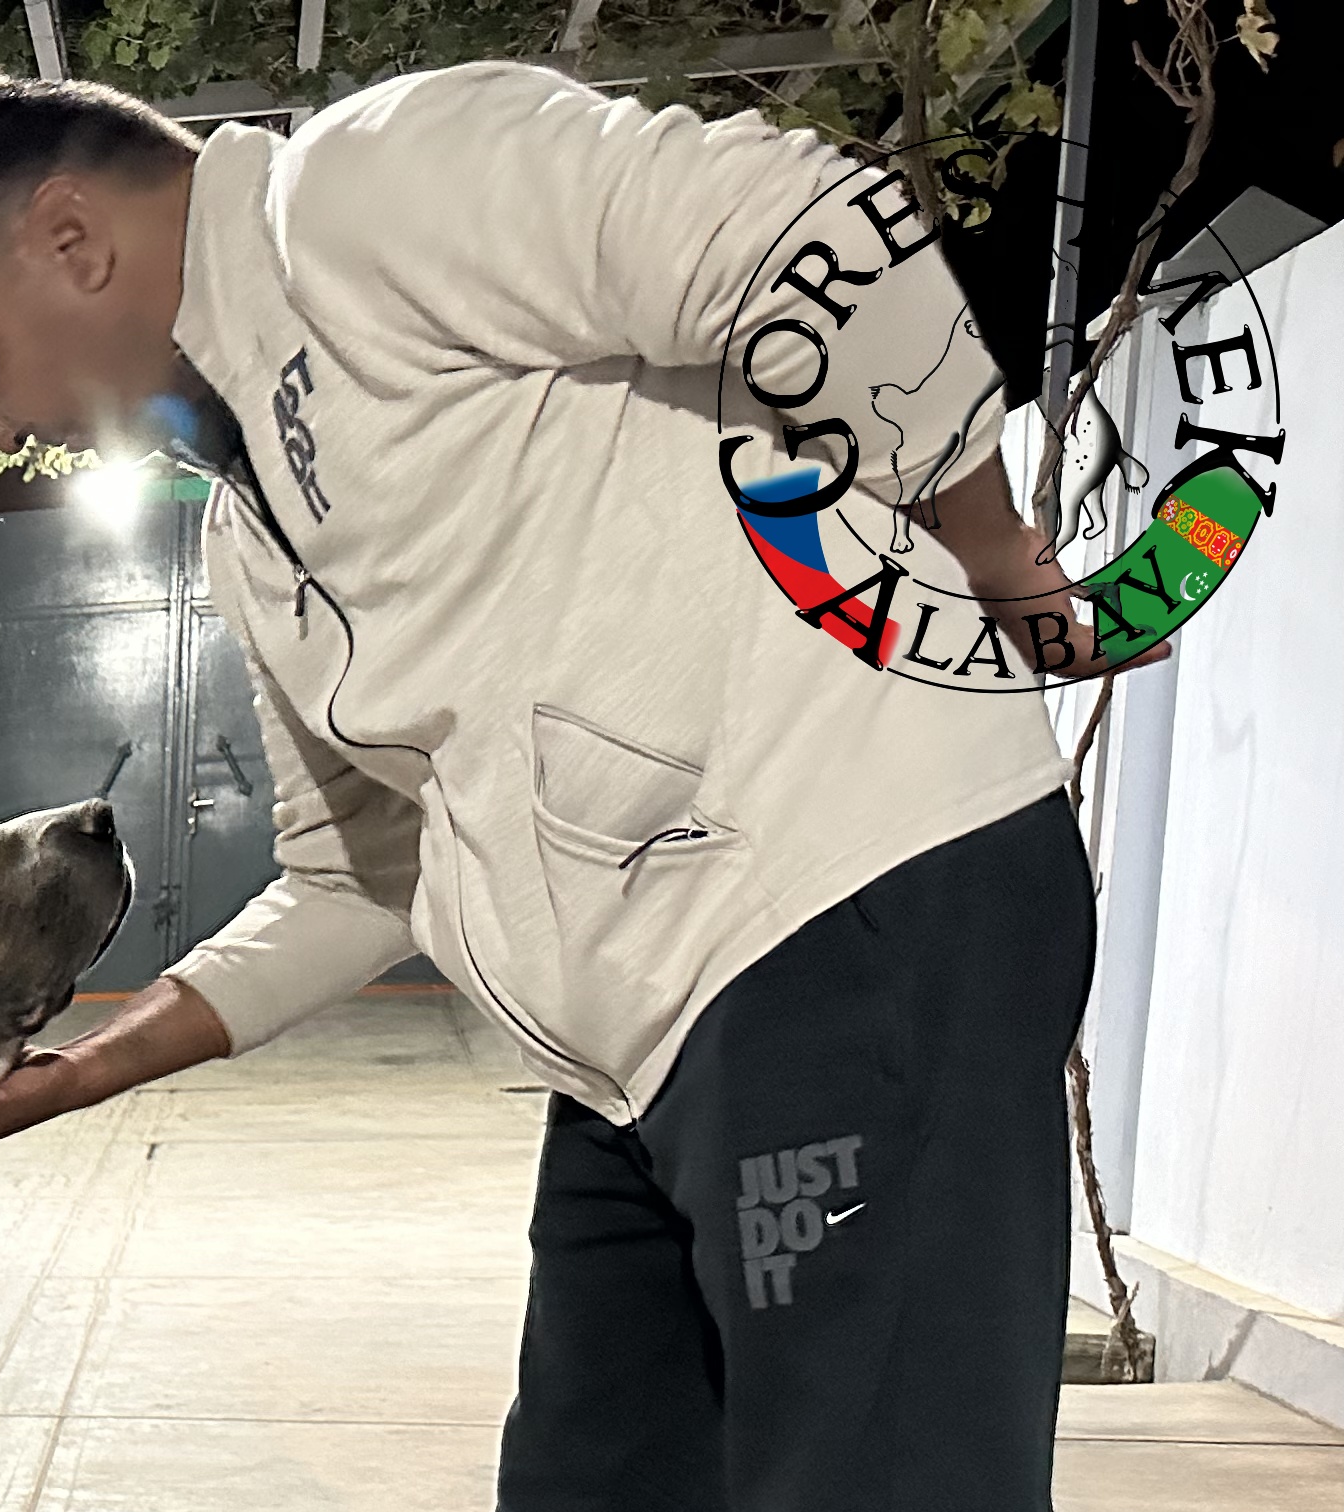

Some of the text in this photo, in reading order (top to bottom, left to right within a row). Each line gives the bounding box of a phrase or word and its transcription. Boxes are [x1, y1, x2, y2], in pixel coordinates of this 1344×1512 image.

[736, 1134, 863, 1212] JUST
[737, 1198, 824, 1258] DO
[743, 1252, 797, 1309] IT
